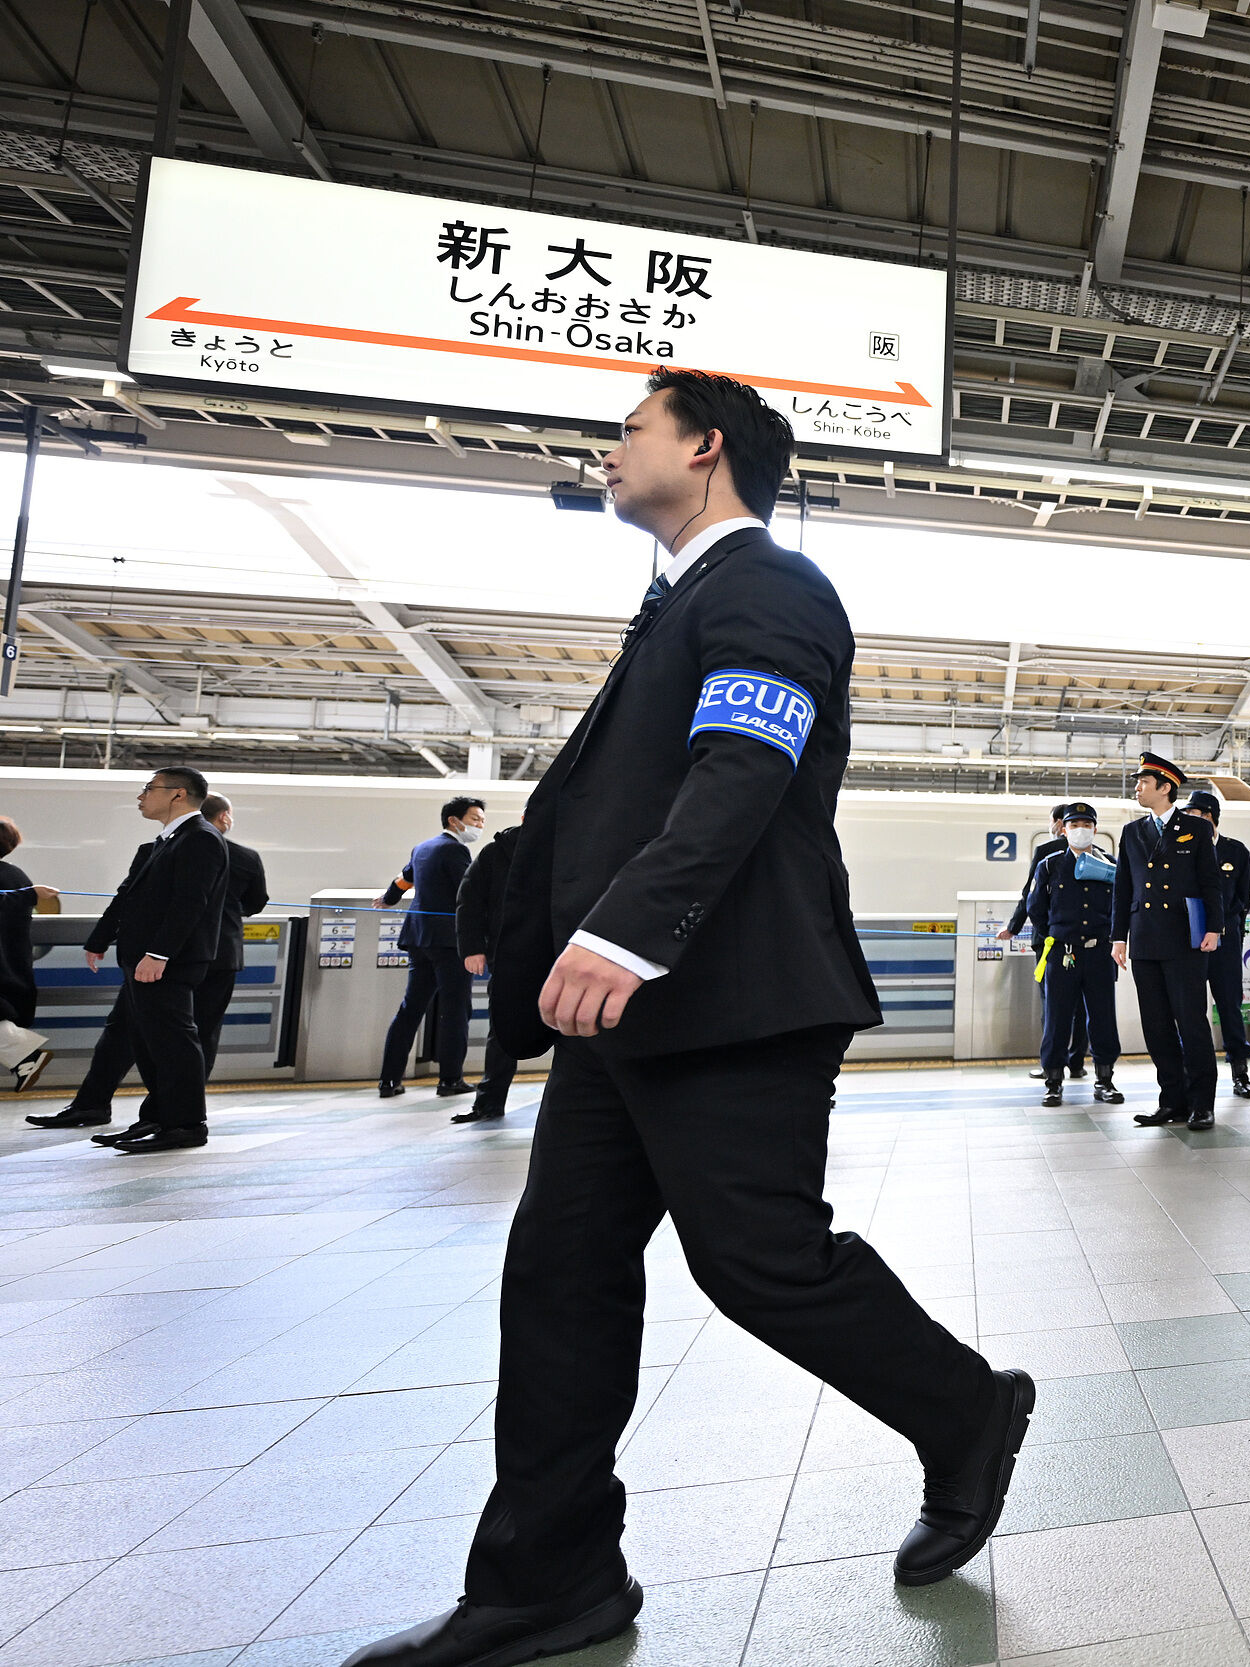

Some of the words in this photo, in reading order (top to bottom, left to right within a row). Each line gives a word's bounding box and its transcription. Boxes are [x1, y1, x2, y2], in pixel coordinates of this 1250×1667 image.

[437, 219, 713, 300] 新大阪
[449, 275, 696, 329] しんおおさか
[170, 327, 293, 359] きょうと
[469, 311, 675, 359] Shin-Ōsaka
[872, 335, 896, 357] 阪
[200, 354, 260, 373] Kyōto
[792, 396, 913, 427] しんこうべ
[813, 420, 892, 440] Shin-Kōbe
[6, 646, 15, 658] 6
[748, 716, 798, 747] ALSOK
[993, 835, 1010, 858] 2
